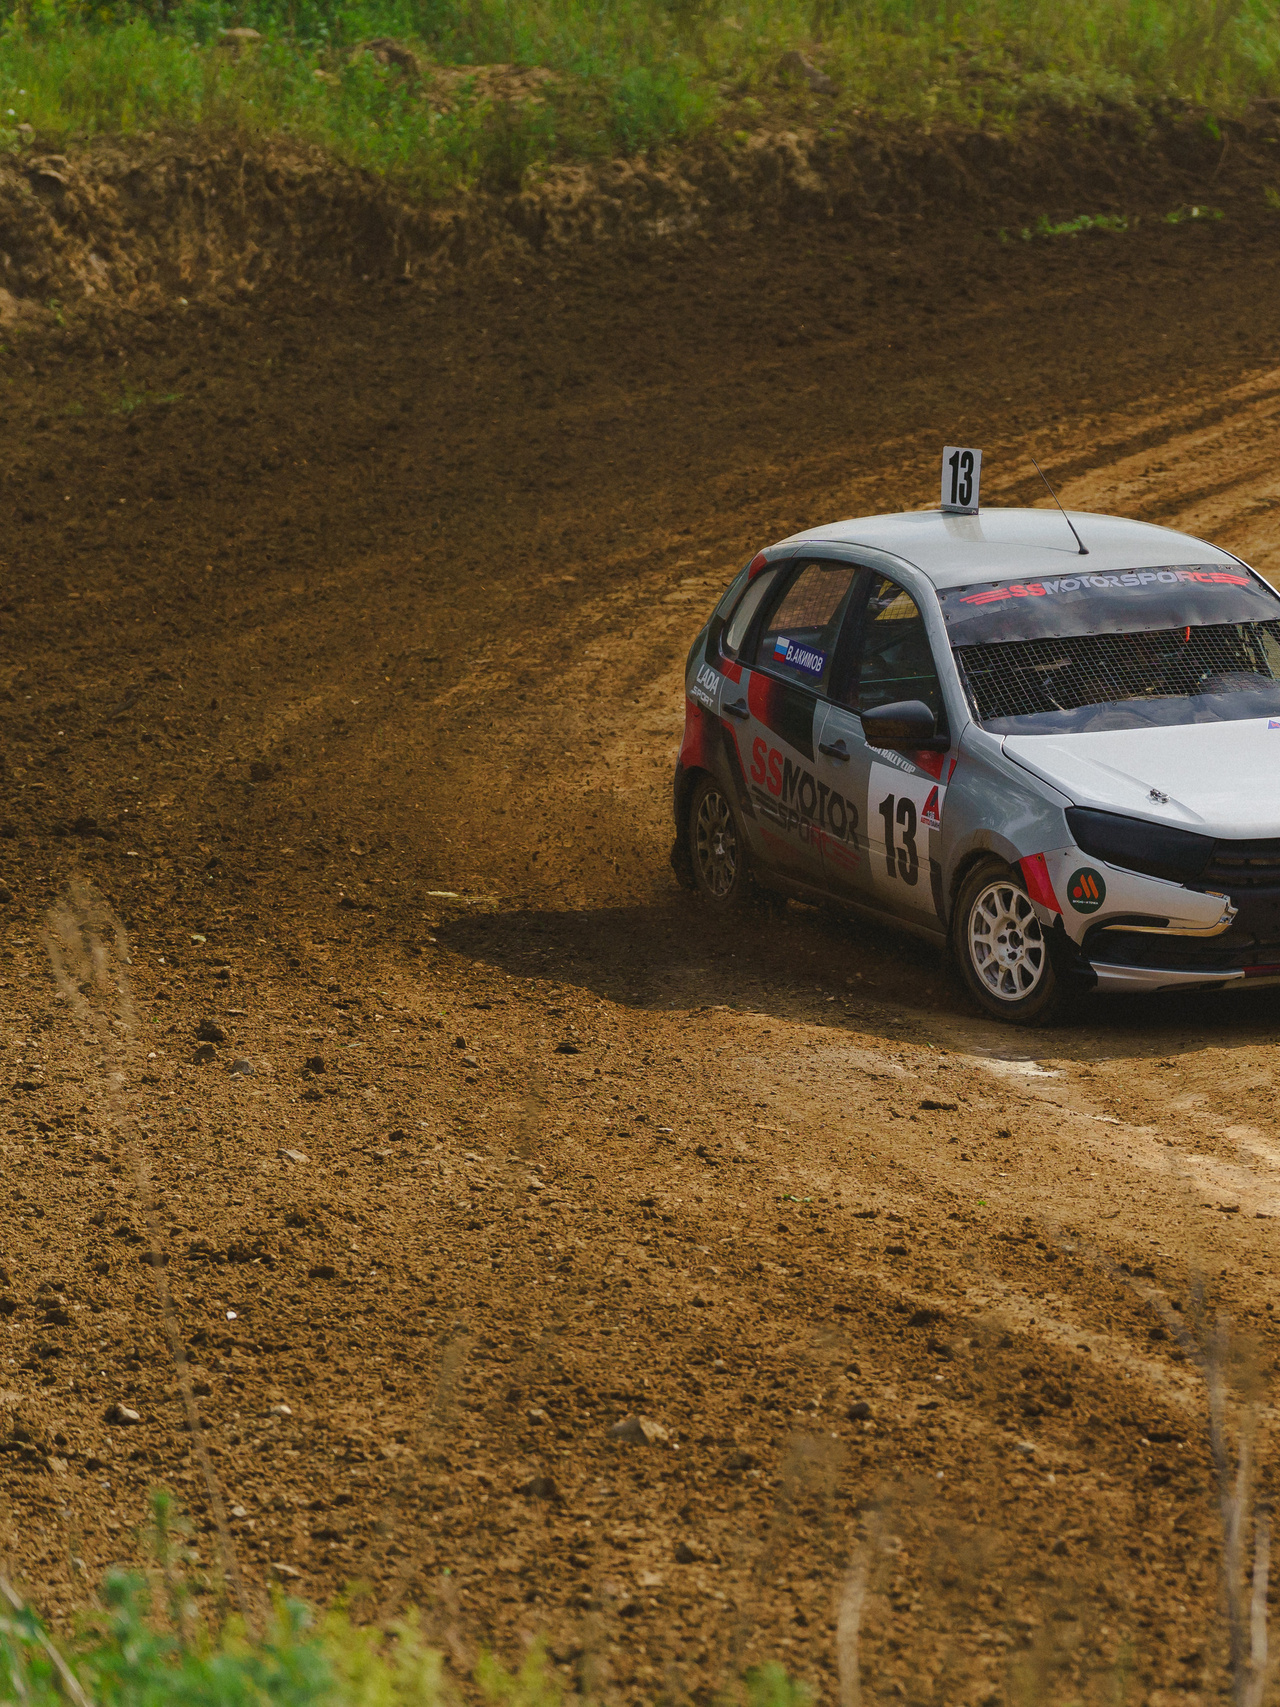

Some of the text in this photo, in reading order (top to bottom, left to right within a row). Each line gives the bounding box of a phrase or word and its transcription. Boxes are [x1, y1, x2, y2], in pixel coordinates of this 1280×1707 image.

[949, 450, 974, 506] 13
[785, 645, 823, 672] В.АКИМОВ
[696, 664, 720, 695] LADA
[690, 685, 714, 707] SPORT
[880, 748, 902, 767] RALLY
[900, 760, 916, 773] CUP
[750, 736, 861, 850] SSMOTOR
[879, 793, 919, 886] 13
